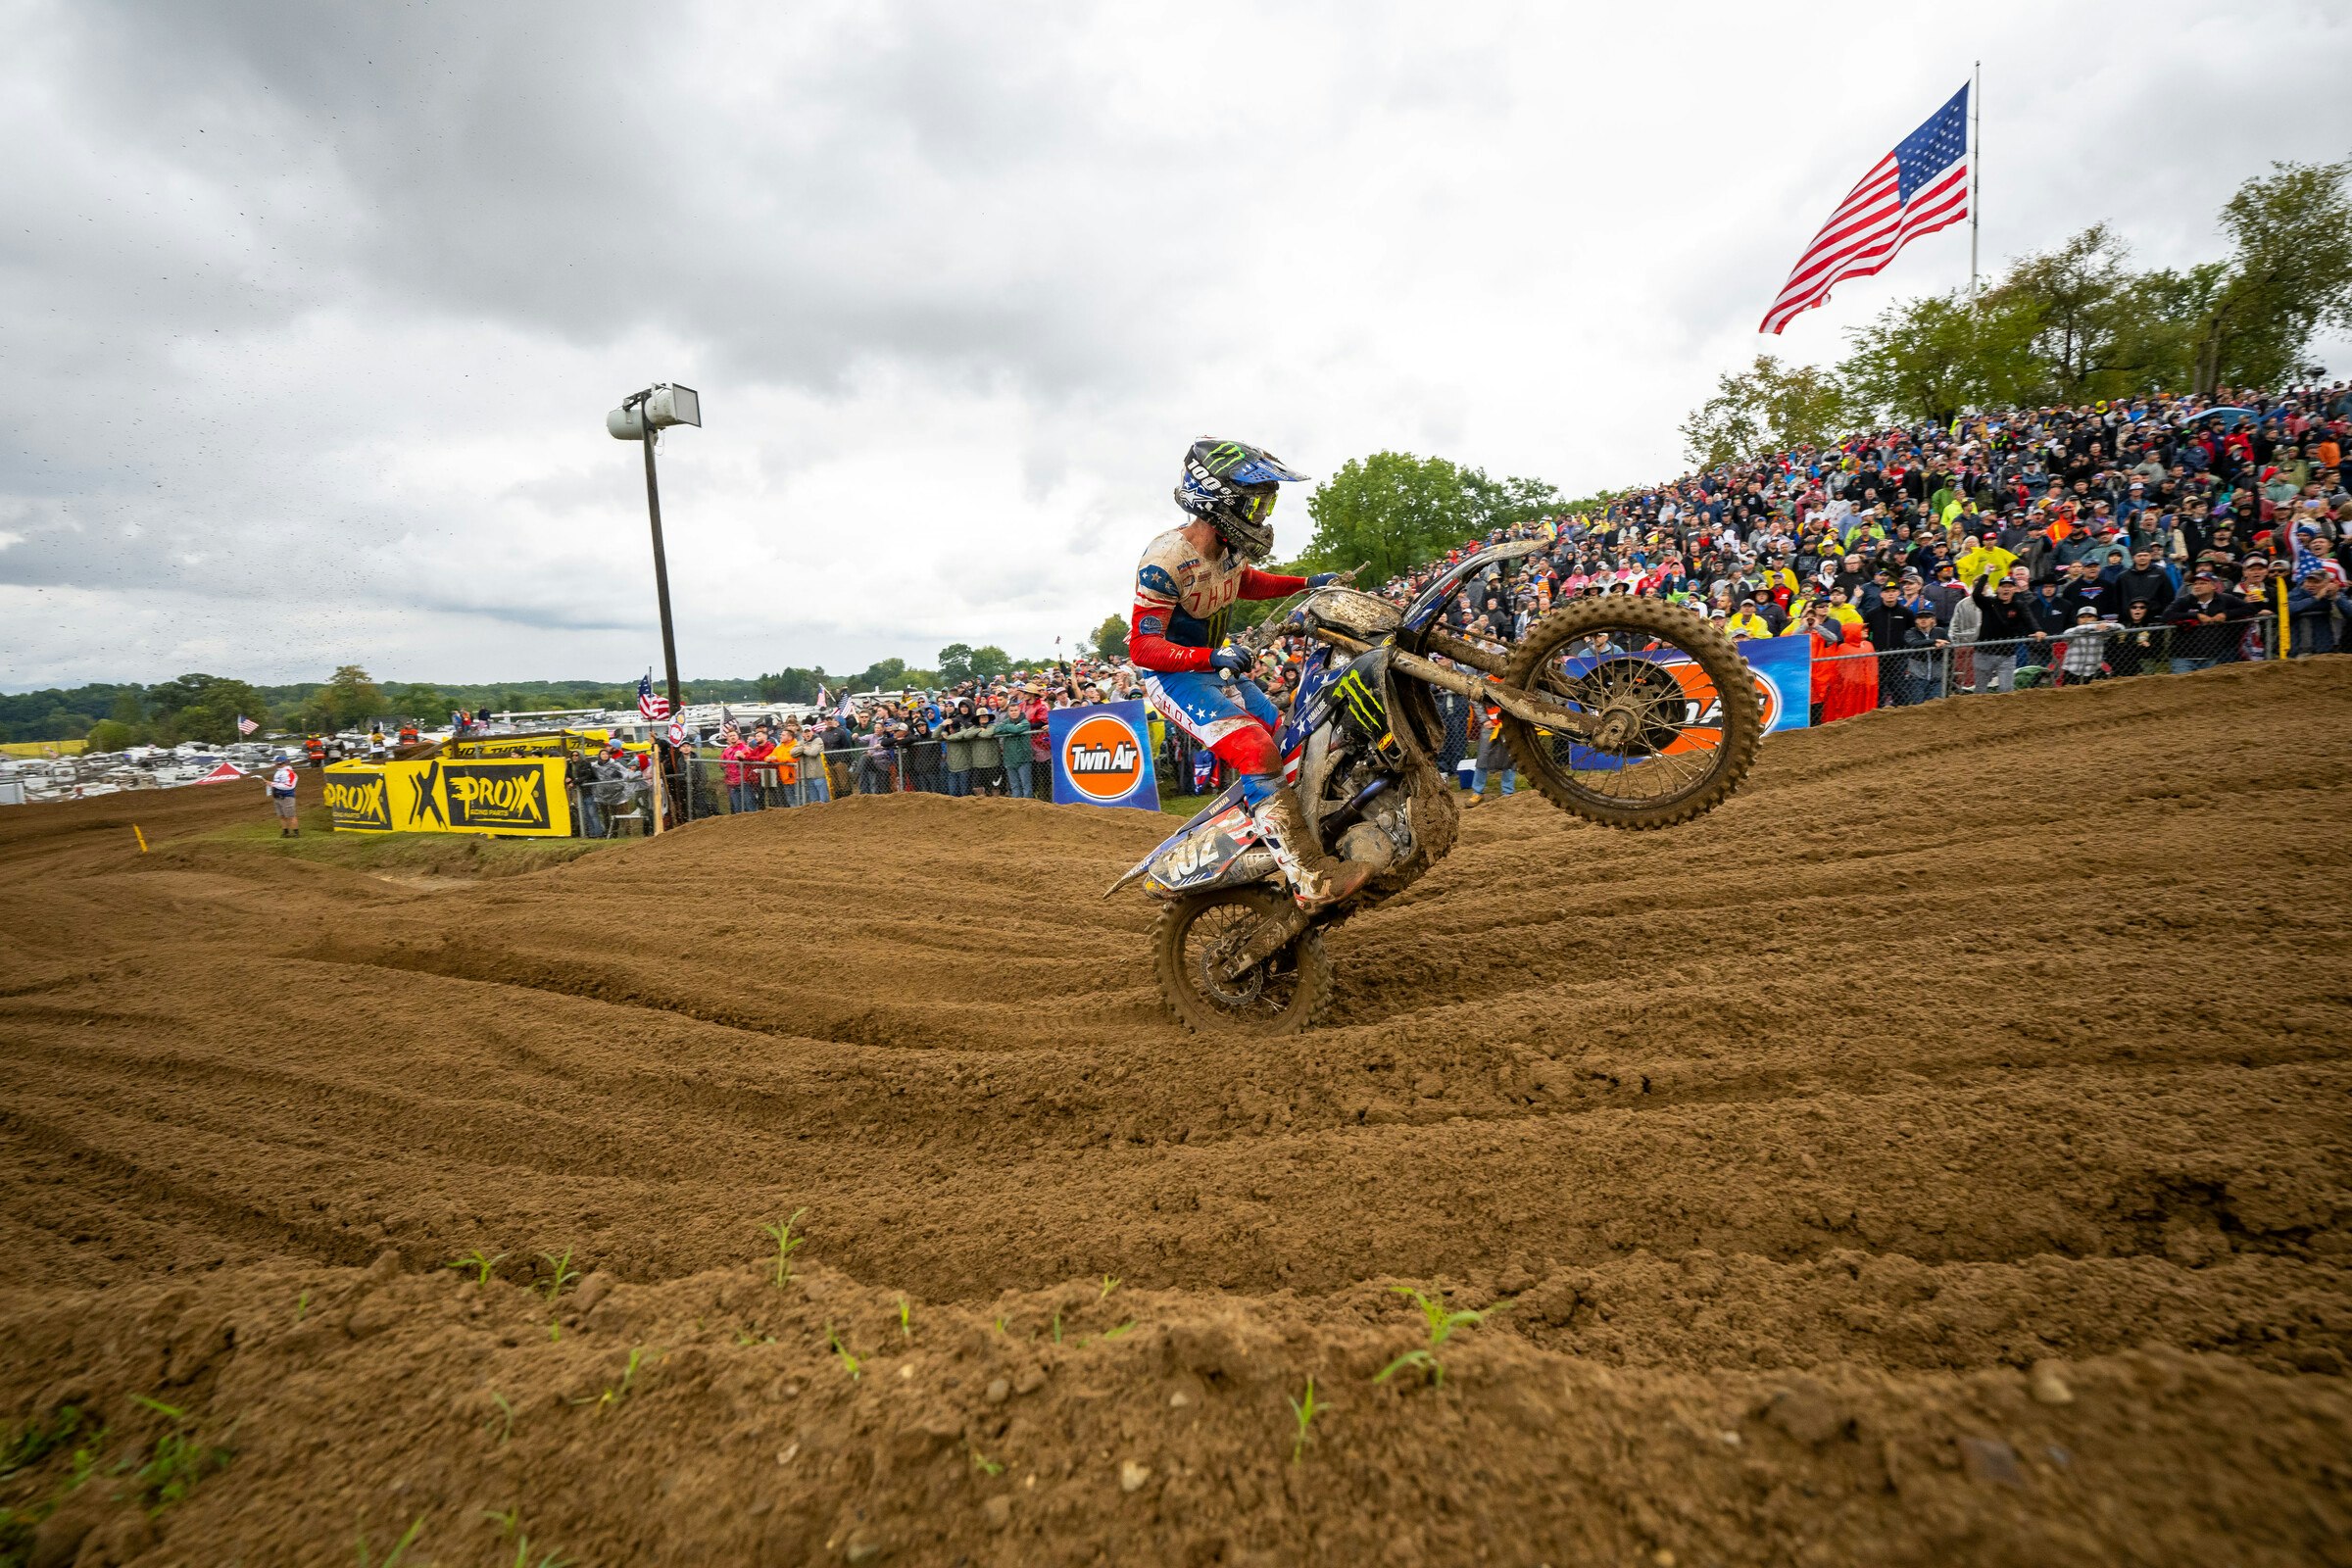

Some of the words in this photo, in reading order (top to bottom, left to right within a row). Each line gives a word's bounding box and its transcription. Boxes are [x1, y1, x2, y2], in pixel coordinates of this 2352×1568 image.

[1187, 458, 1241, 507] 100%
[1071, 741, 1111, 772] Twin
[1111, 741, 1138, 771] Air
[1208, 796, 1230, 815] YAMAHA
